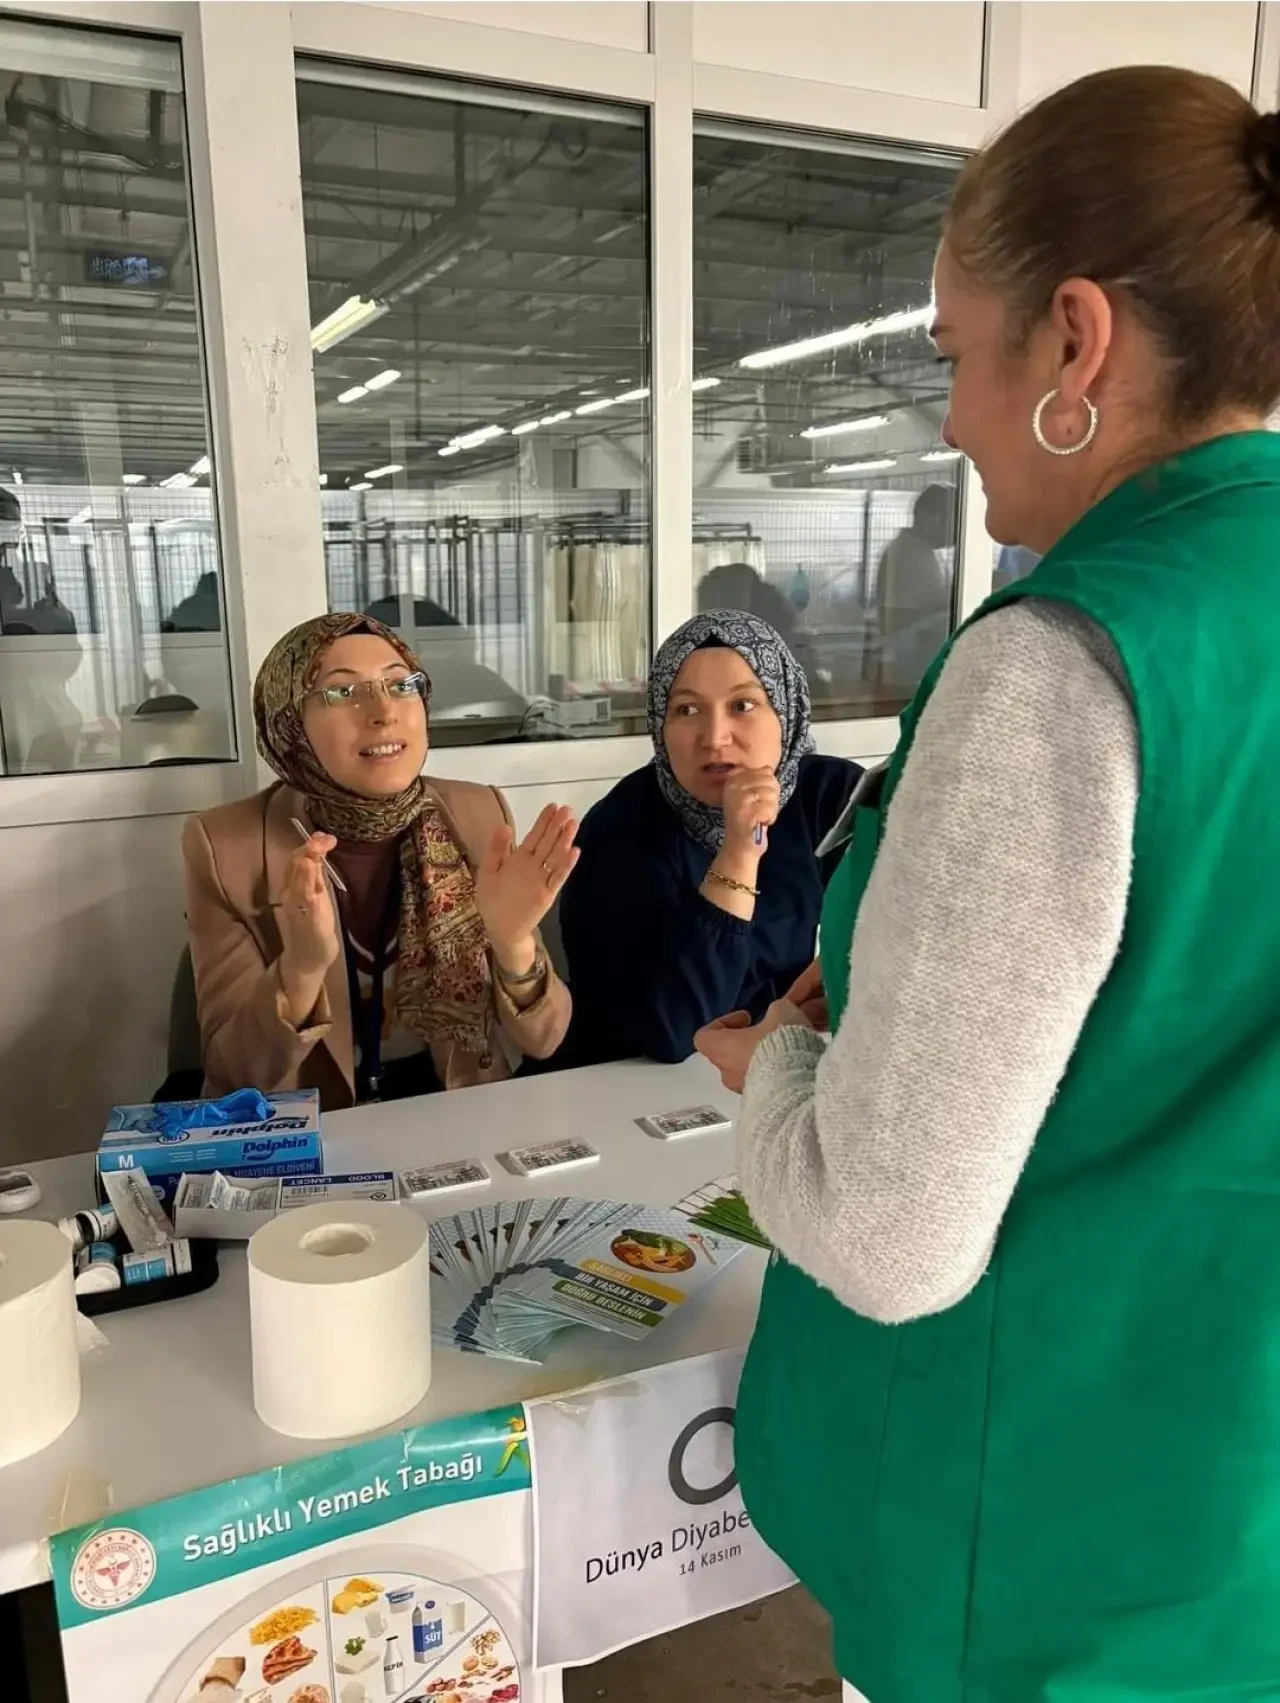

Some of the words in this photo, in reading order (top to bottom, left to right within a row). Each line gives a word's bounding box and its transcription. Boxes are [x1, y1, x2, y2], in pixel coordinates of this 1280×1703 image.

[242, 1136, 308, 1160] Dolphin
[118, 1154, 134, 1169] M
[290, 1177, 333, 1186] LANCET
[347, 1173, 386, 1182] BLOOD
[183, 1508, 292, 1561] Sağlıklı
[297, 1475, 391, 1524] Yemek
[396, 1452, 483, 1491] Tabağı
[586, 1541, 663, 1583] Dünya
[671, 1510, 750, 1553] Diyabe
[679, 1560, 695, 1576] 14
[701, 1543, 742, 1568] Kasım
[424, 1630, 442, 1645] SÜT
